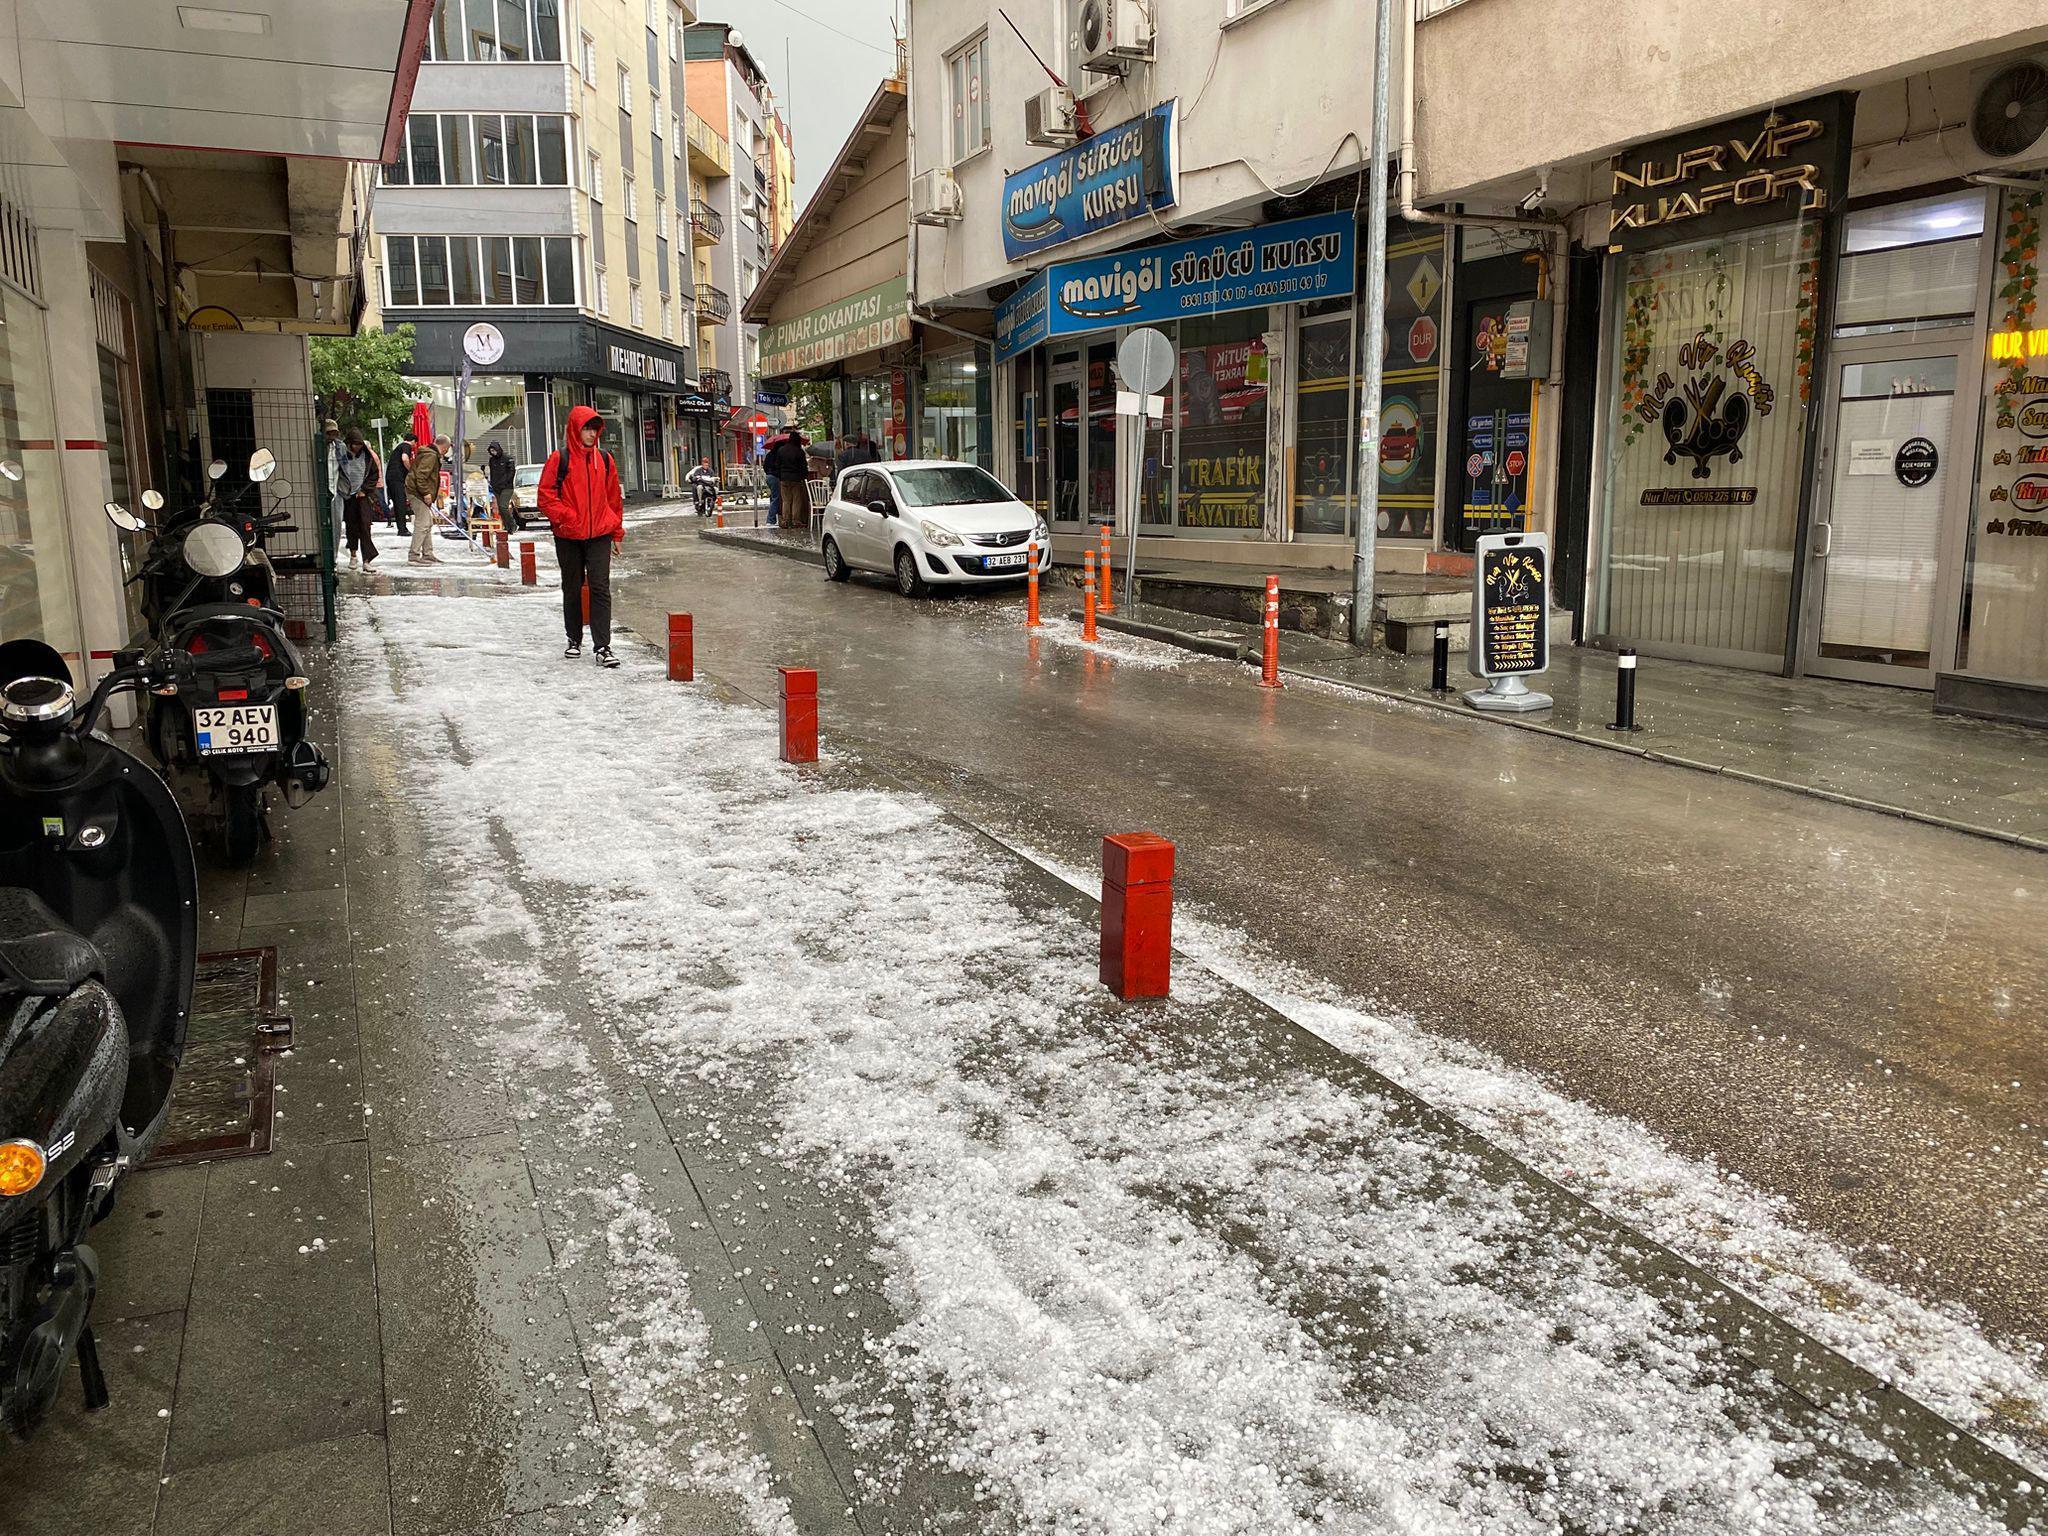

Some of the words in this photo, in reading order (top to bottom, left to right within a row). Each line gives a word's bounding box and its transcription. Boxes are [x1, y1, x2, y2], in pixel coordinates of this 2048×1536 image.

[1010, 157, 1074, 214] mavigöl
[1077, 128, 1143, 181] SÜRÜCÜ
[1612, 145, 1727, 195] NUR
[1083, 174, 1138, 221] KURSU
[1610, 165, 1820, 232] KUAFÖR
[1063, 256, 1161, 304] mavigöl
[1170, 241, 1254, 287] SÜRÜCÜ
[1261, 232, 1341, 272] KURSU
[1180, 294, 1201, 308] 0541
[1203, 291, 1219, 305] 311
[1222, 289, 1234, 303] 49
[1236, 288, 1246, 301] 17
[1254, 282, 1277, 297] 0246
[1280, 279, 1297, 293] 311
[1300, 276, 1312, 290] 49
[1315, 274, 1327, 289] 17
[777, 317, 811, 347] PINAR
[814, 295, 880, 336] LOKANTASI
[1413, 332, 1432, 345] DUR
[1992, 331, 2024, 359] NUR
[608, 345, 645, 377] MEHMET
[650, 356, 676, 384] AYDINLI
[760, 394, 771, 402] Tek
[1187, 448, 1260, 486] TRAFİK
[1644, 492, 1660, 503] Nur
[987, 557, 996, 566] 32
[199, 711, 226, 727] 32
[232, 708, 271, 725] AEV
[229, 727, 269, 745] 940
